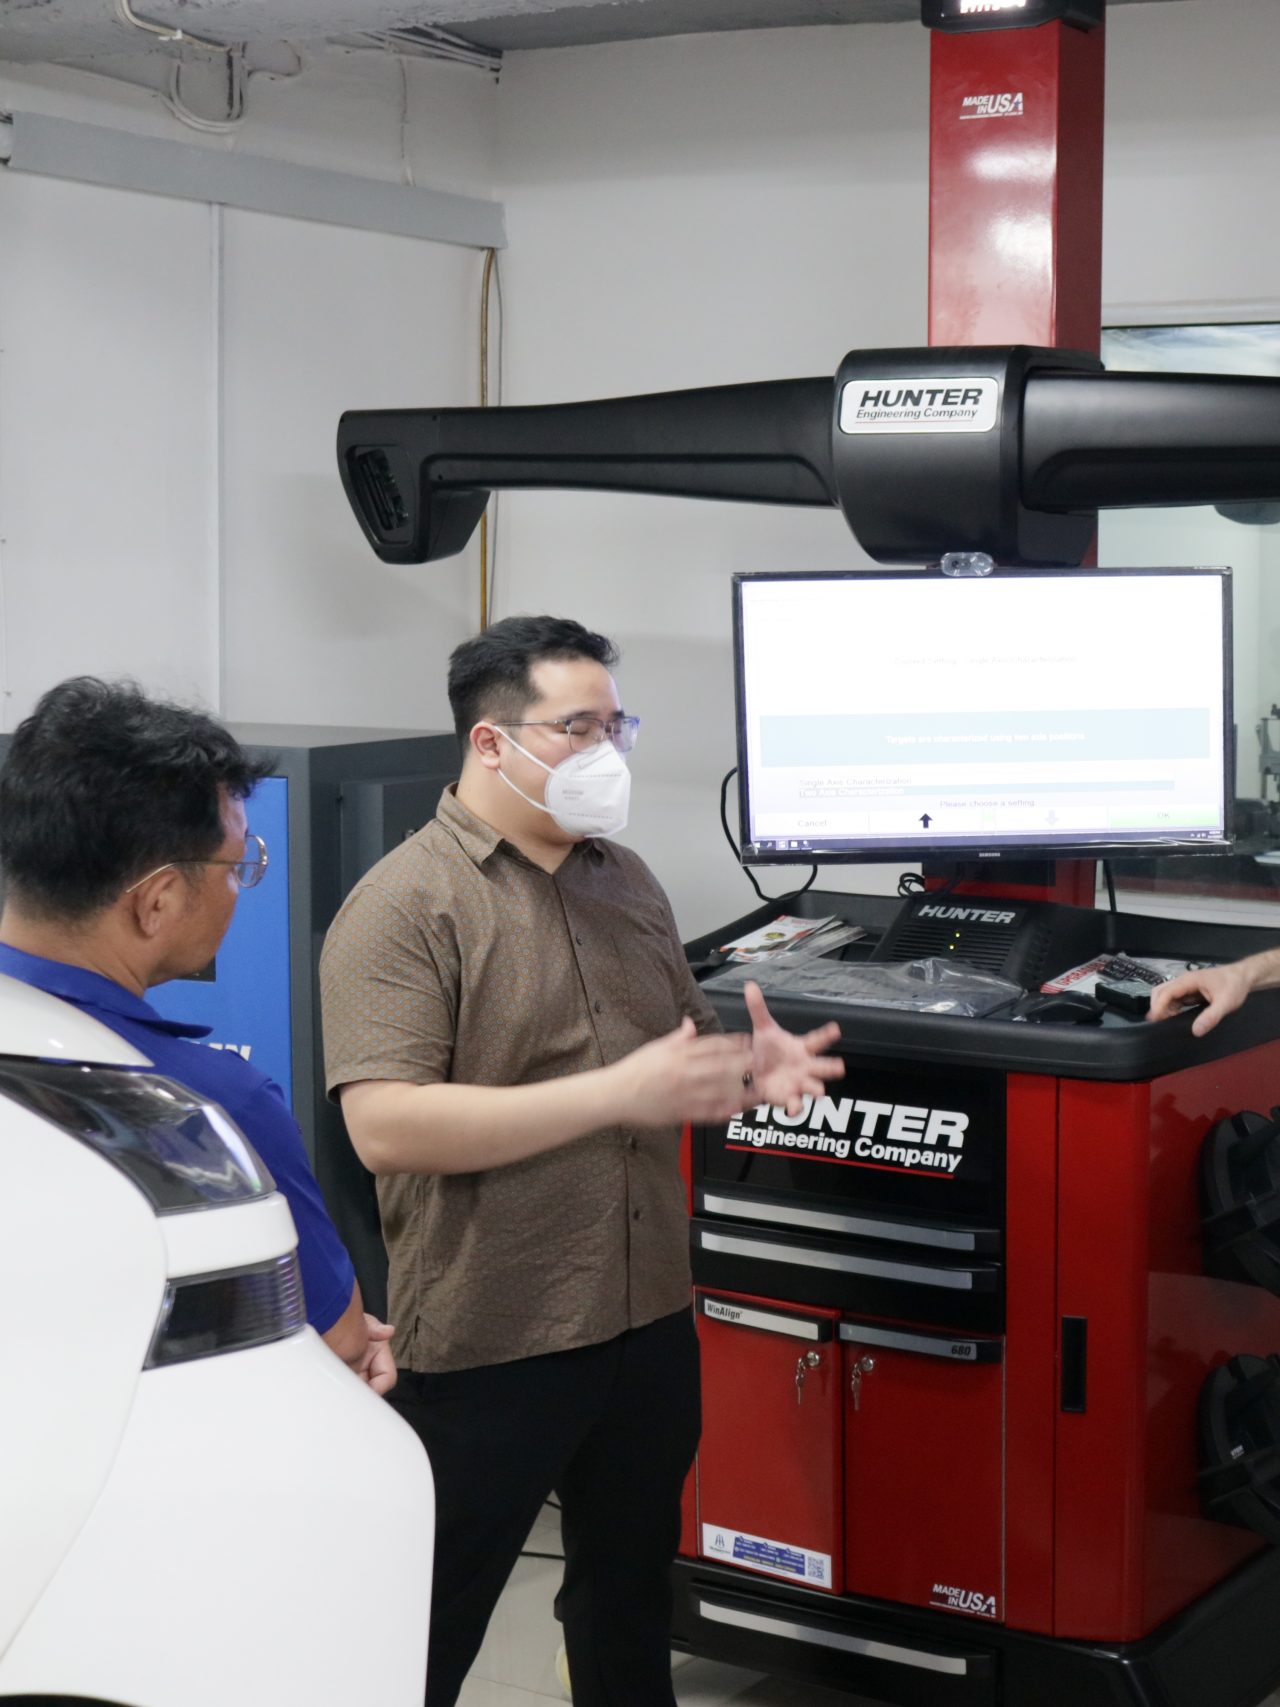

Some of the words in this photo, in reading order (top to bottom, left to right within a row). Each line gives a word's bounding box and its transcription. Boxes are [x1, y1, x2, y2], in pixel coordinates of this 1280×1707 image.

[962, 95, 991, 106] MADE
[987, 92, 1024, 114] USA
[860, 388, 983, 407] HUNTER
[856, 408, 921, 420] Engineering
[923, 407, 978, 418] Company
[918, 904, 1016, 924] HUNTER
[726, 1121, 850, 1158] Engineering
[854, 1136, 962, 1172] Company
[706, 1303, 741, 1320] WinAlign
[951, 1344, 971, 1356] 680
[932, 1583, 961, 1598] MADE
[958, 1590, 996, 1615] USA
